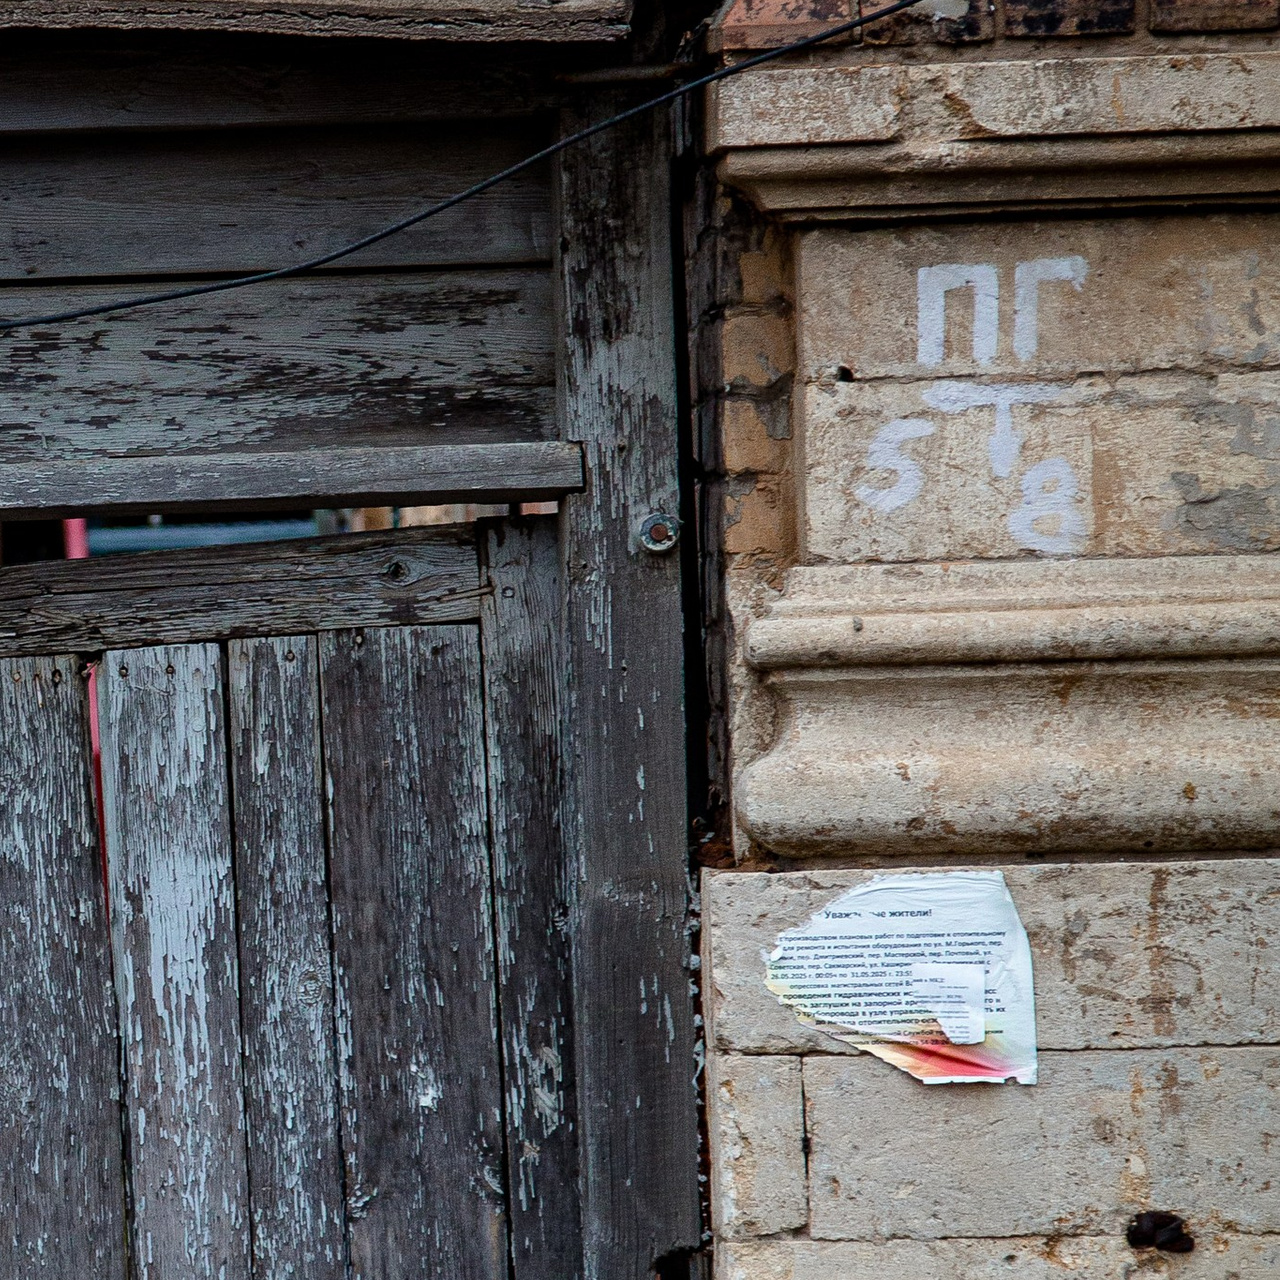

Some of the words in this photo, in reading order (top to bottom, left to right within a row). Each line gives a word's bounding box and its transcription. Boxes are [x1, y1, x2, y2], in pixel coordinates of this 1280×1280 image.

[888, 908, 933, 918] жители!
[874, 932, 895, 940] работ
[782, 992, 832, 1000] проведения
[833, 990, 901, 998] гидравлических
[863, 998, 903, 1007] запорной
[869, 1009, 888, 1018] узле
